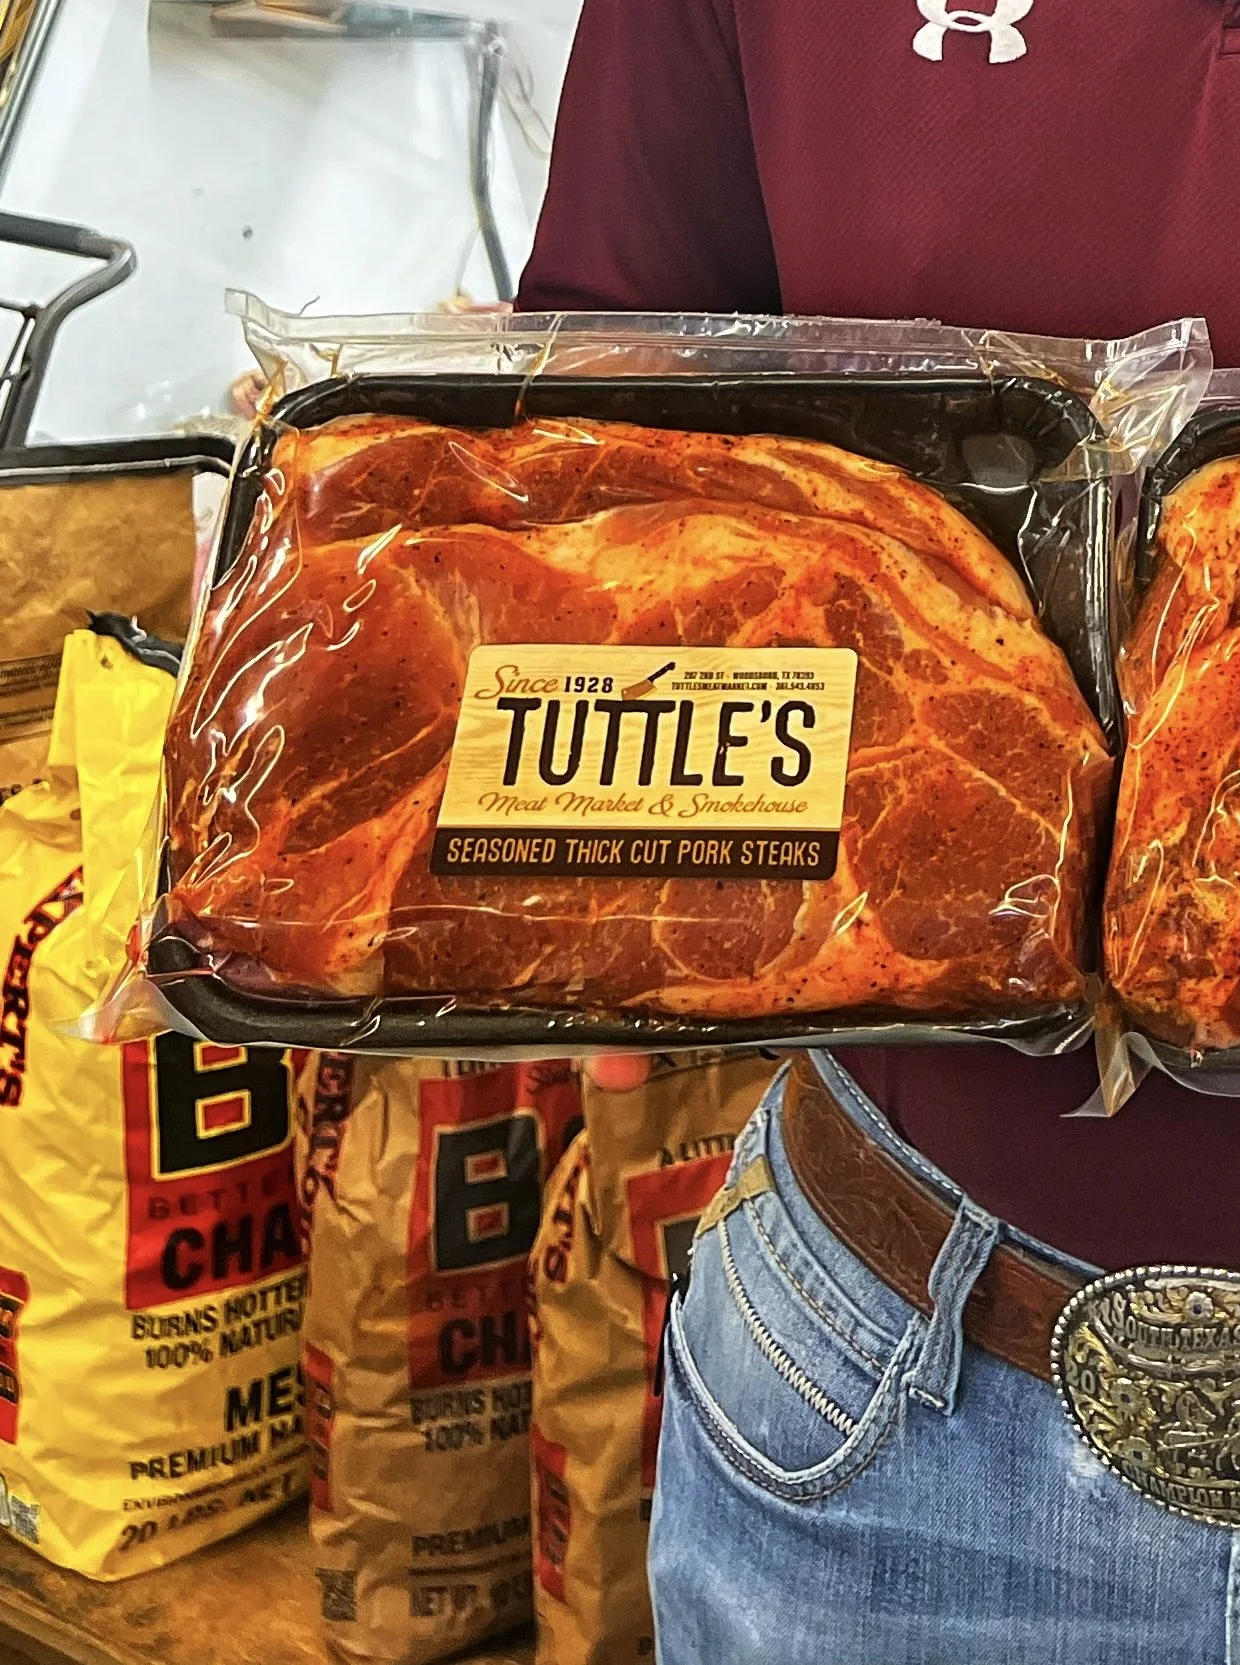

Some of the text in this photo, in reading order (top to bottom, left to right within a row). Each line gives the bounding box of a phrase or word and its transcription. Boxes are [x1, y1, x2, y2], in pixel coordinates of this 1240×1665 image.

[474, 664, 613, 700] Since 1928
[497, 697, 816, 786] TUTTLE'S
[478, 790, 808, 819] Meat Market & Smokehouse
[447, 838, 820, 867] SEASONED THICK CUT PORK STEAKS
[131, 1305, 219, 1340] BURNS
[145, 1337, 214, 1369] 100%
[440, 1310, 531, 1375] CH
[128, 1430, 260, 1480] PREMIUM
